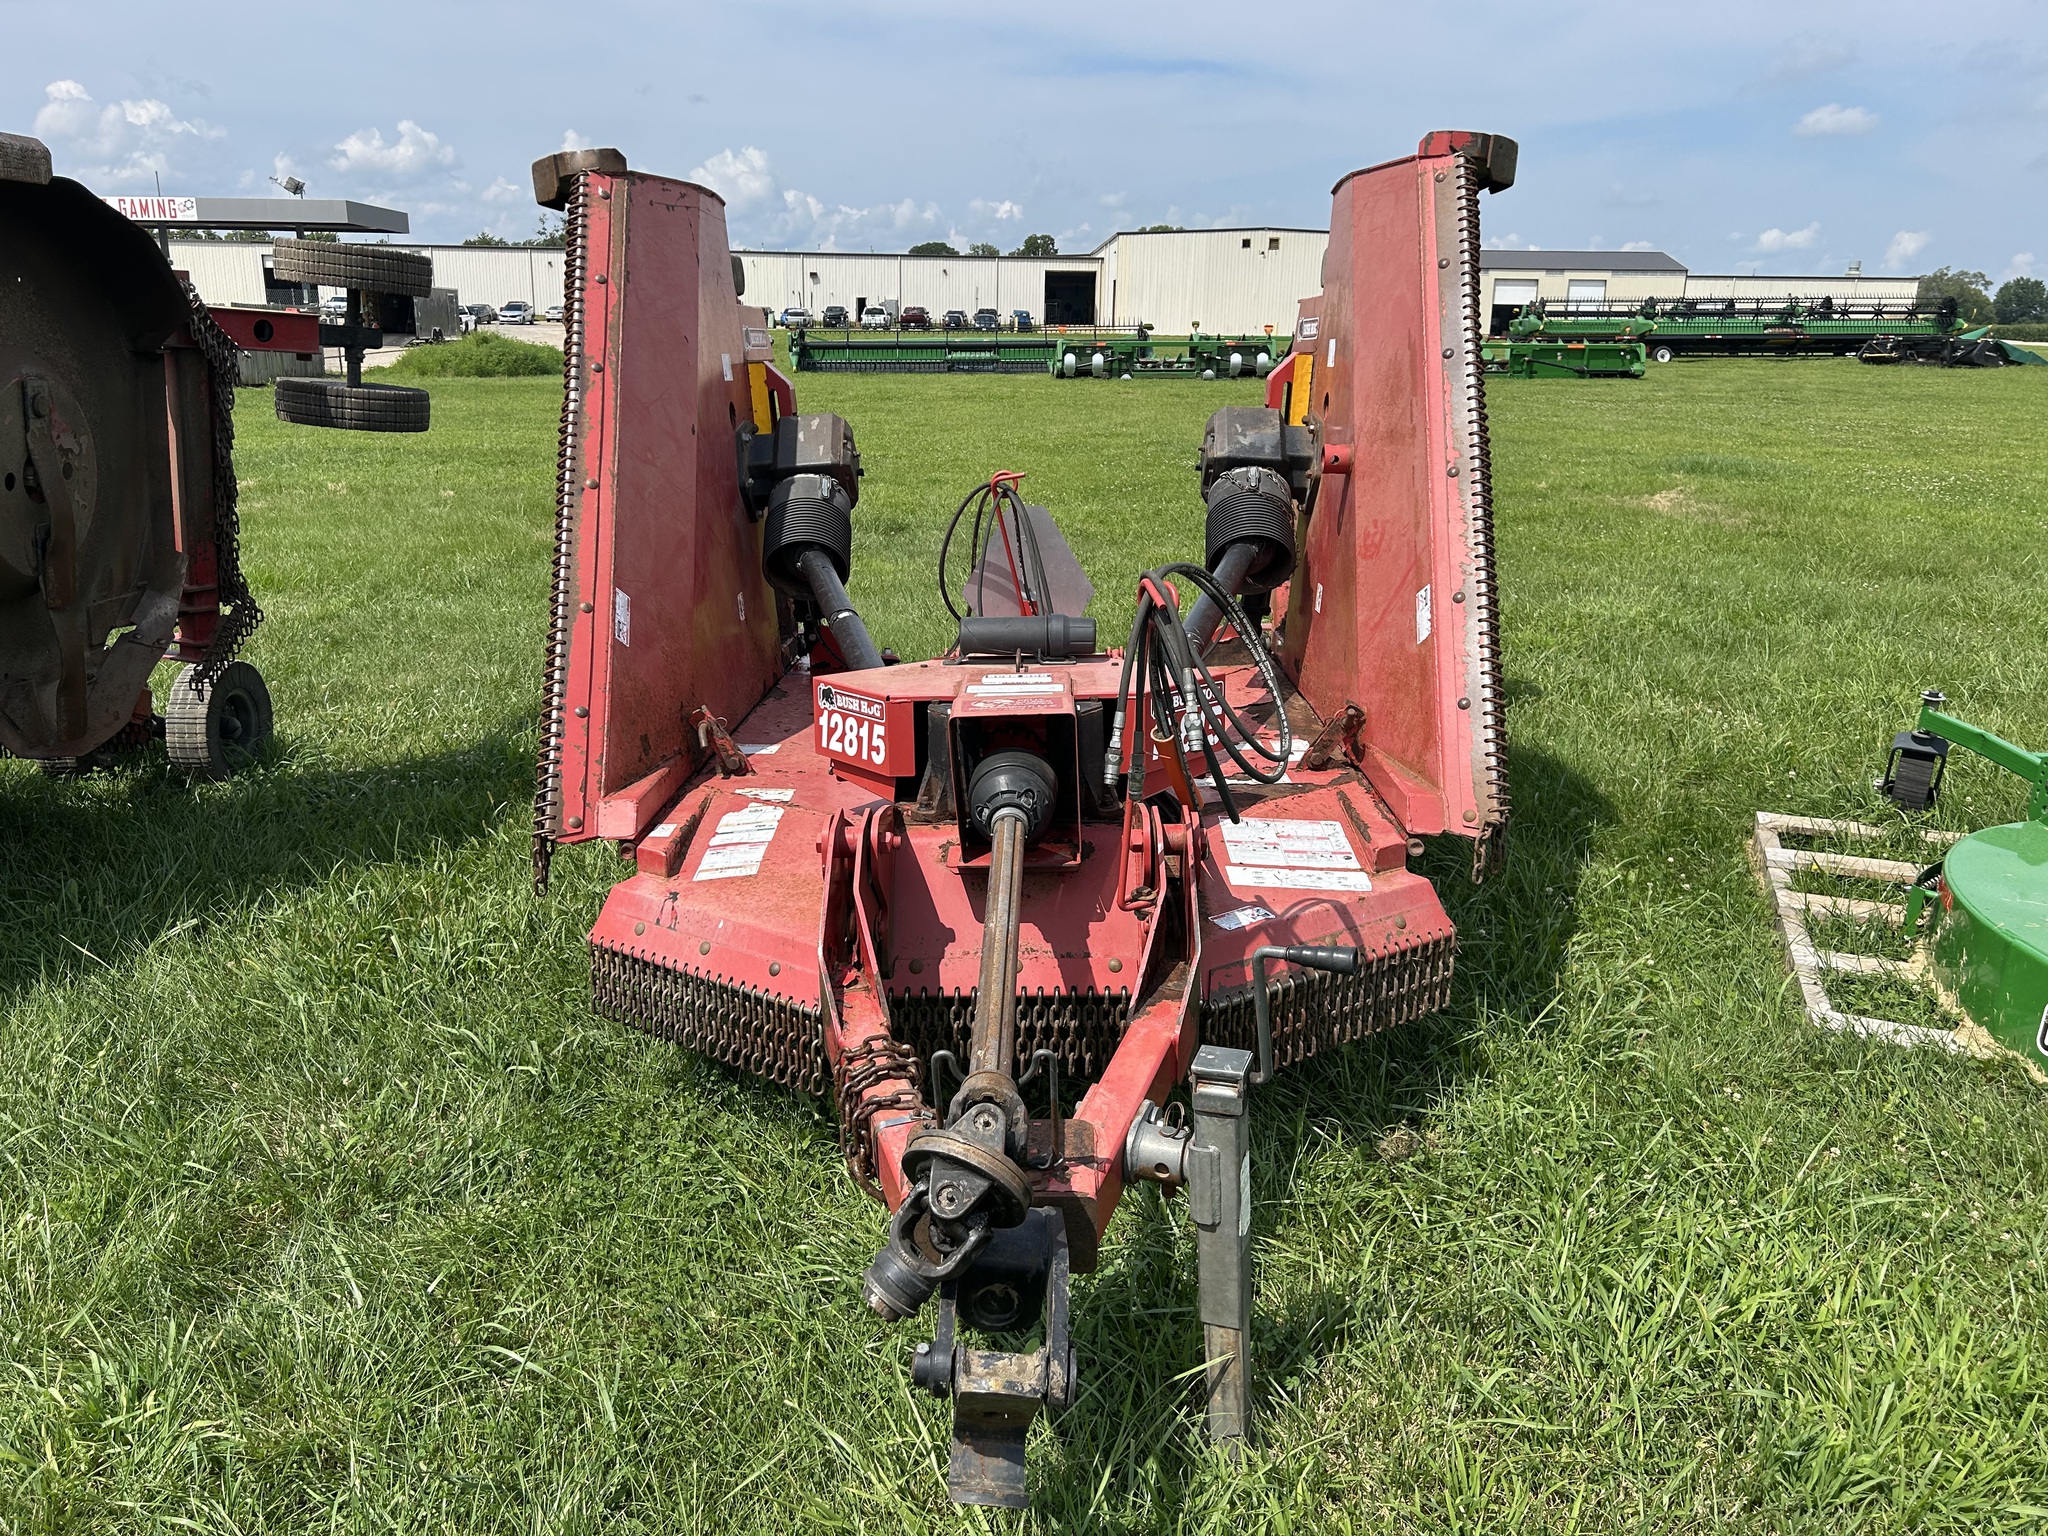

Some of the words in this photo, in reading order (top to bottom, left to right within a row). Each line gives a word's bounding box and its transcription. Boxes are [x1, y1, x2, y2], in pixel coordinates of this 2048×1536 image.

[118, 198, 177, 218] GAMING
[836, 694, 860, 711] BUSH
[861, 700, 882, 717] HOG
[818, 709, 886, 765] 12815
